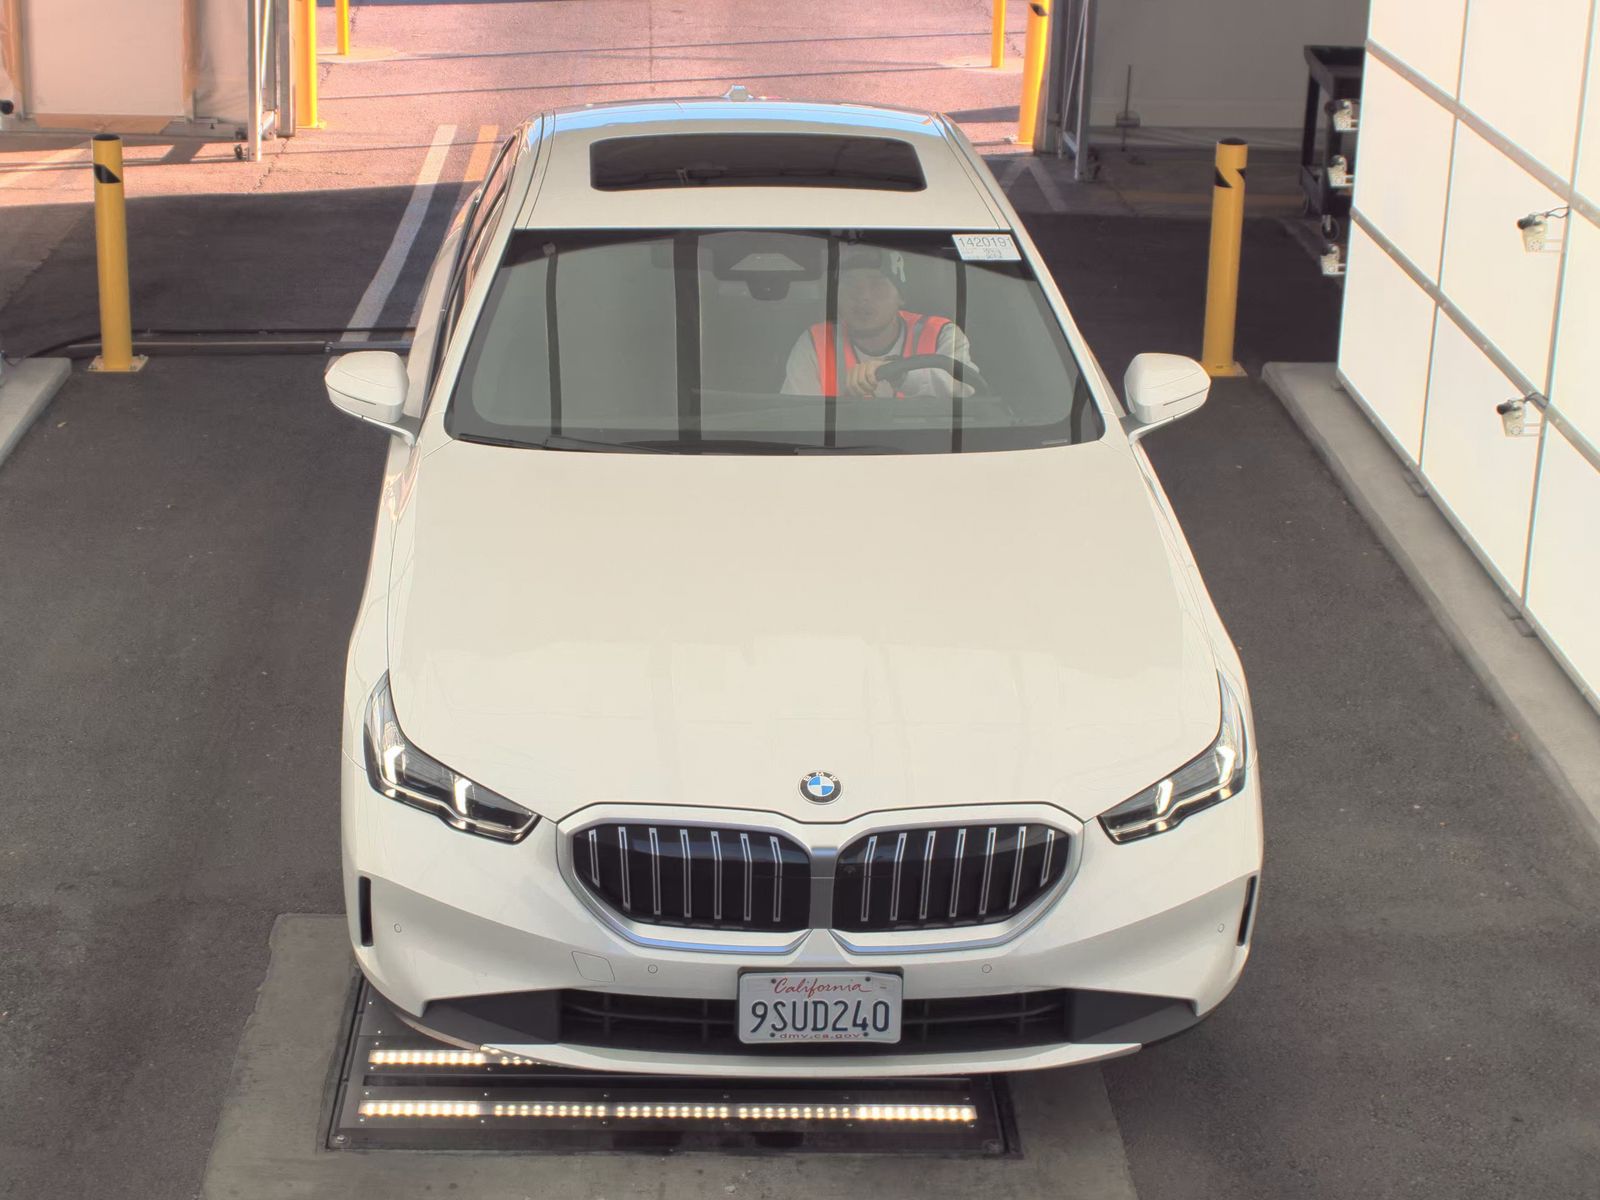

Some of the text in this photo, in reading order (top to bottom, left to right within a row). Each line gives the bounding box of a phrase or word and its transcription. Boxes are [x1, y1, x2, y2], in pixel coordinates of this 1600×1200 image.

[958, 236, 1014, 248] 1420191
[773, 977, 873, 999] California
[750, 1000, 890, 1033] 9SUD240
[779, 1031, 861, 1040] dmv.ca.gov
